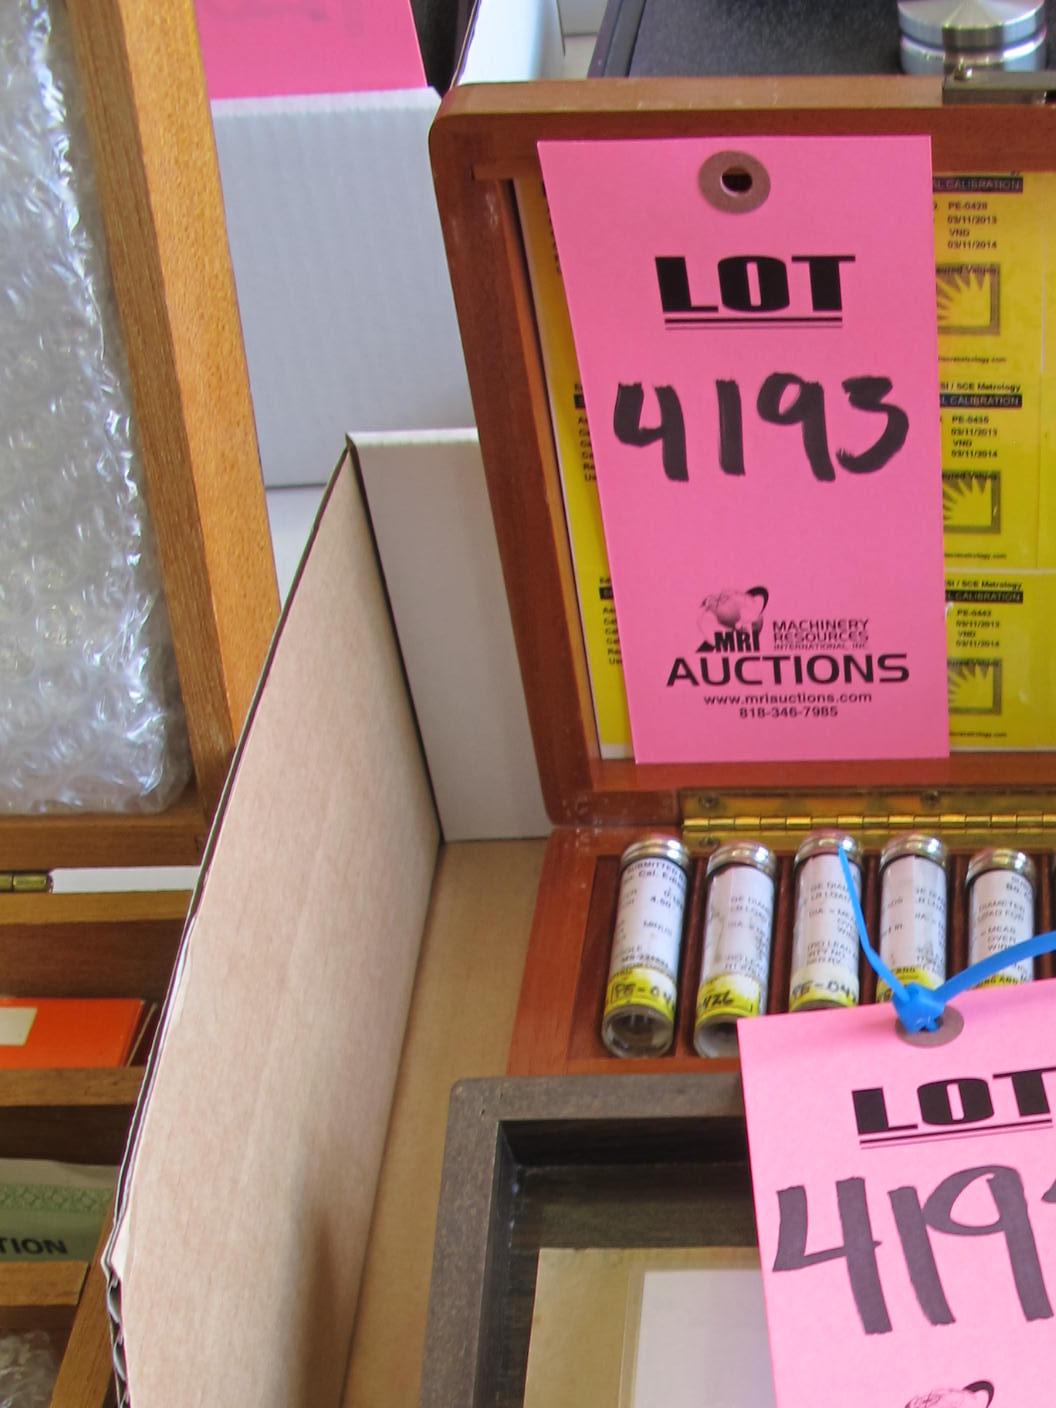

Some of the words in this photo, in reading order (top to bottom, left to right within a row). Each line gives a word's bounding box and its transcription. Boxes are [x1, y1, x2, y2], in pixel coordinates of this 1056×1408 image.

[655, 254, 856, 313] LOT
[612, 372, 910, 482] 4193
[772, 619, 869, 633] MACHINERY
[714, 628, 761, 652] MRI
[773, 632, 869, 643] RESOURCES
[666, 653, 910, 687] AUCTIONS
[703, 693, 873, 705] www.mriauctions.com
[739, 706, 839, 718] 818-346-7985
